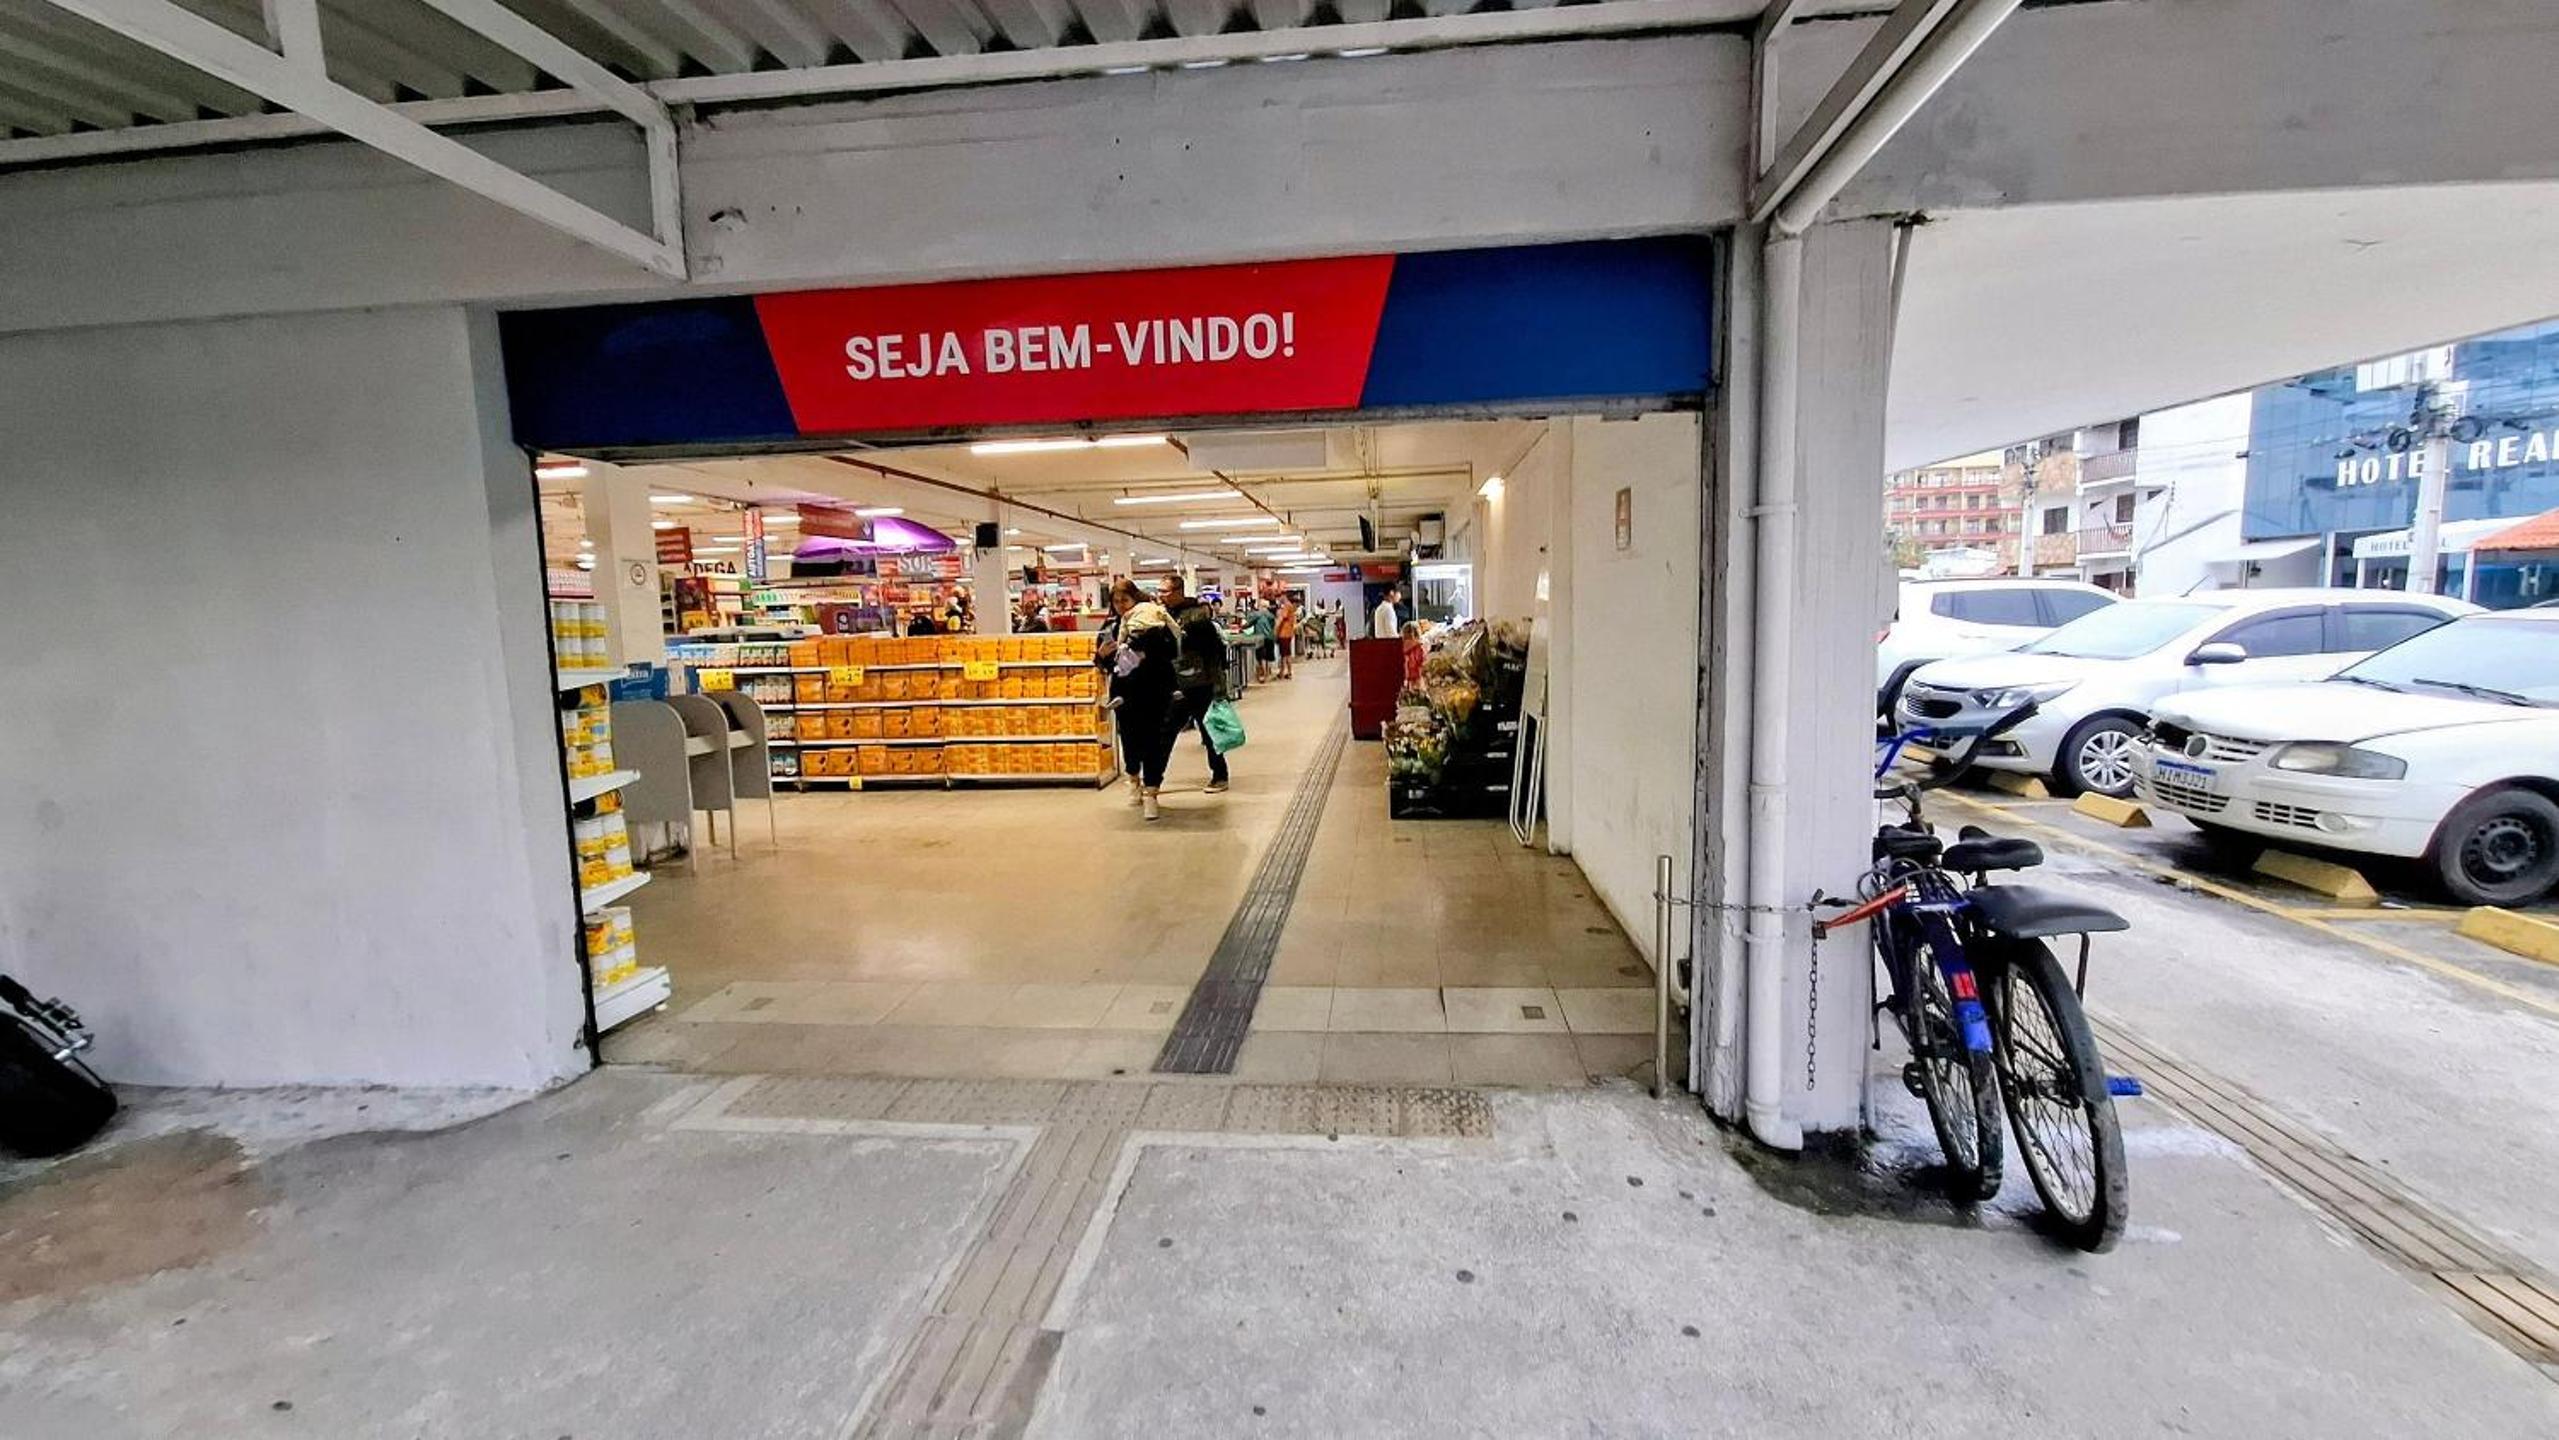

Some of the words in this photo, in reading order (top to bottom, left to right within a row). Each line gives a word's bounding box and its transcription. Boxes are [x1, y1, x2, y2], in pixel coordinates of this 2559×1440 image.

[845, 331, 970, 380] SEJA
[984, 312, 1295, 375] BEM-VINDO!
[2337, 450, 2450, 487] HOTE
